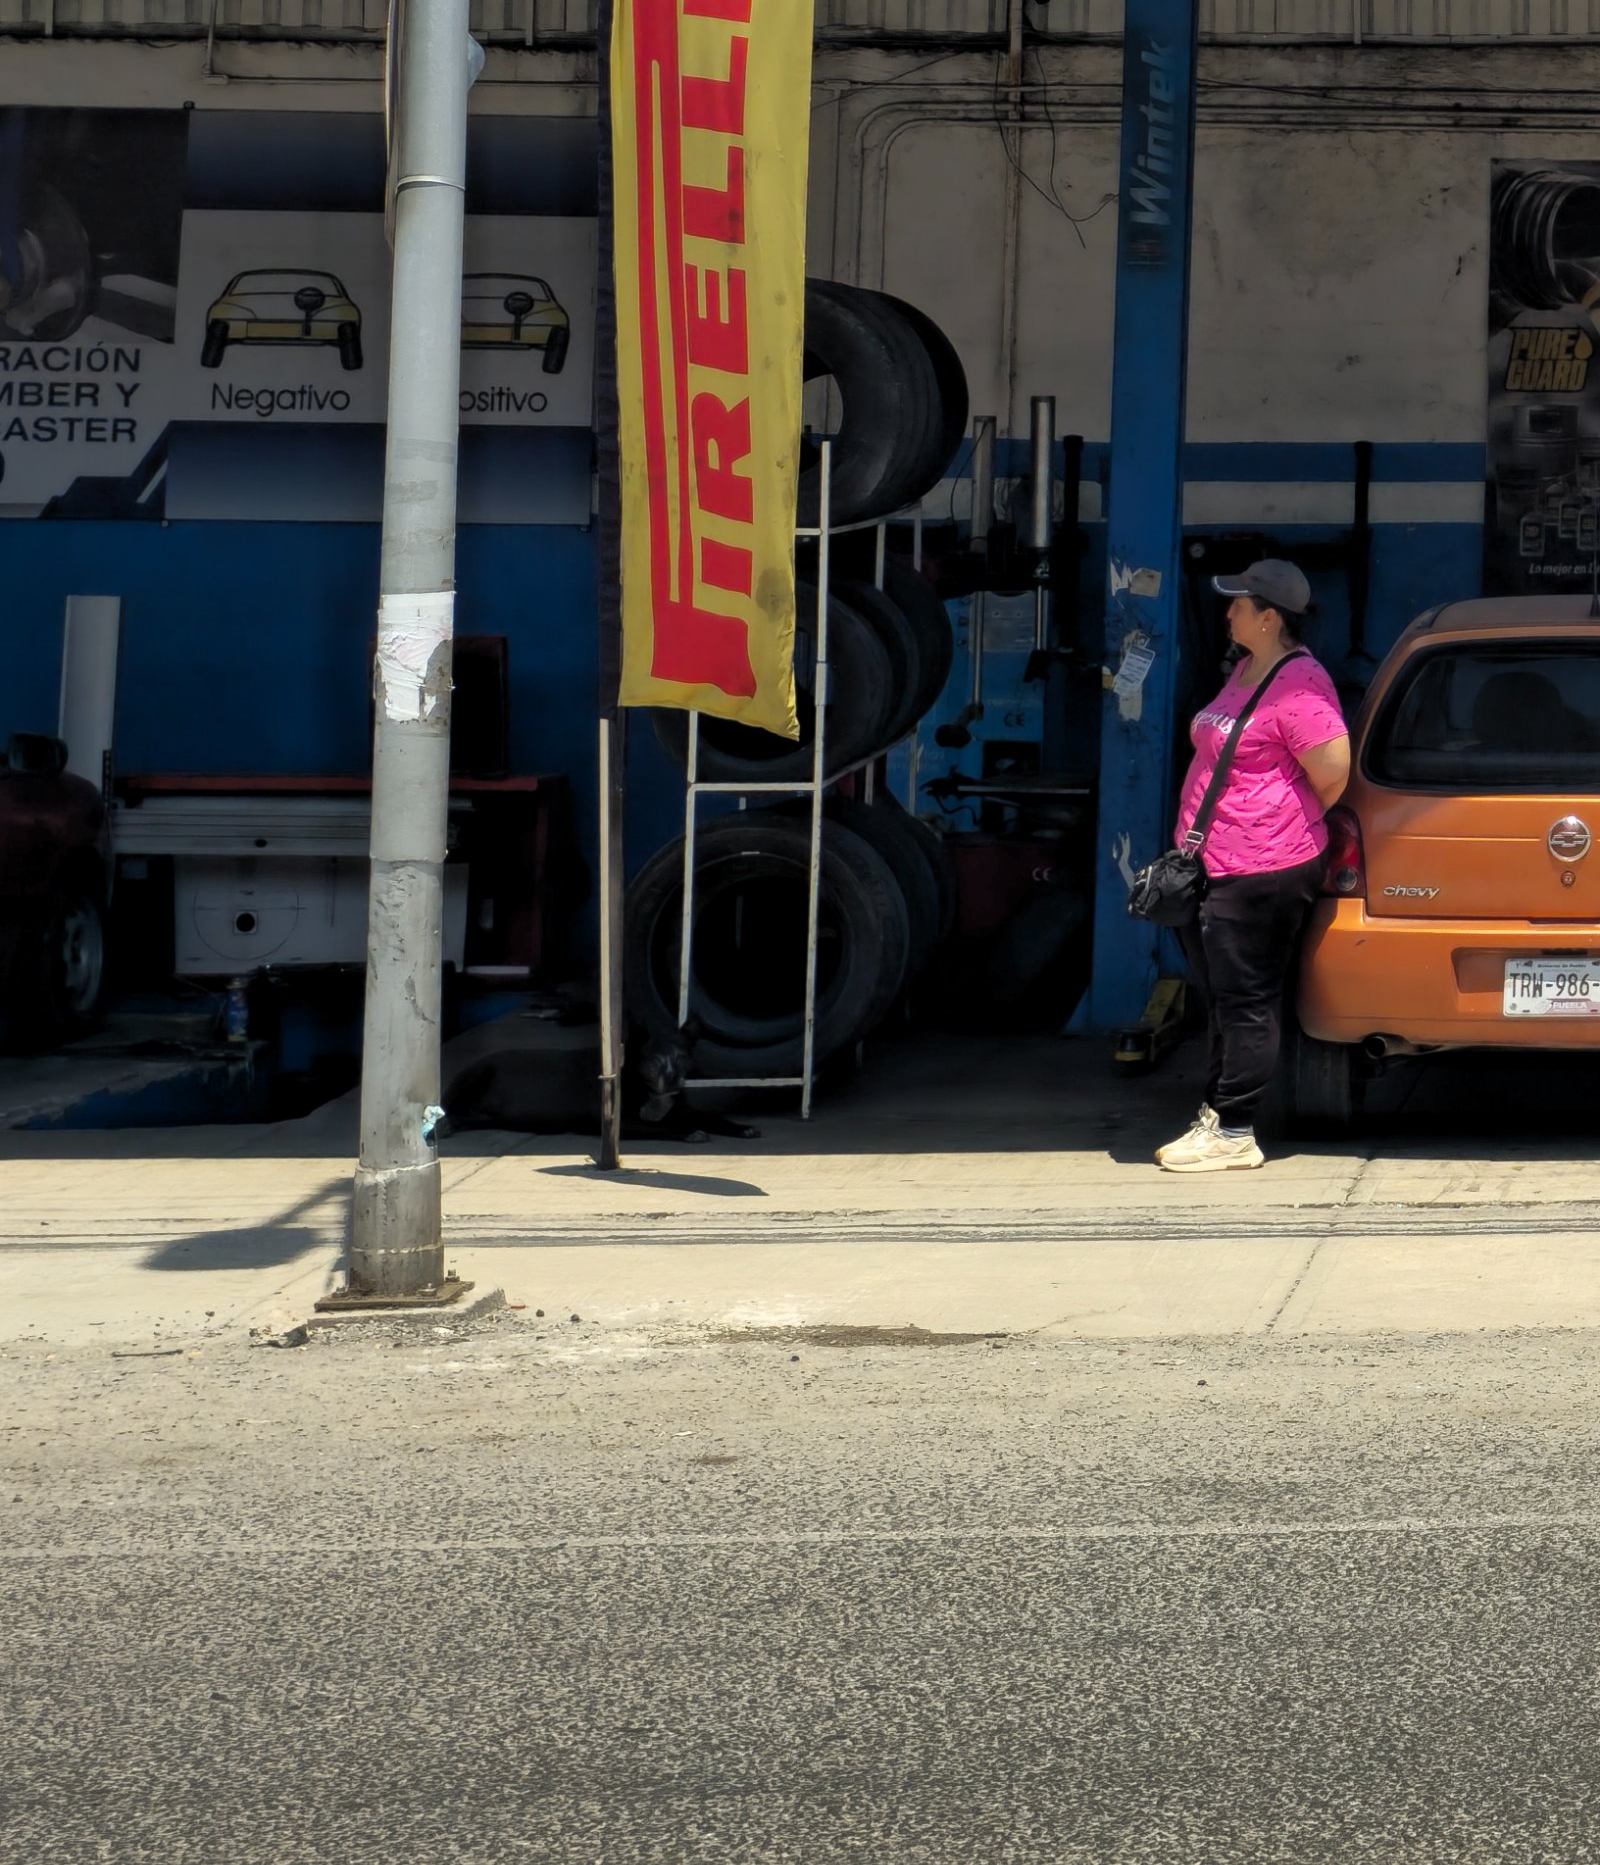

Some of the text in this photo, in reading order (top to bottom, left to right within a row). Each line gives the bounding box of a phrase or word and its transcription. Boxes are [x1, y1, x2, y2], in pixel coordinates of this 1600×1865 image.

[1129, 38, 1176, 226] Wintek
[1513, 328, 1576, 360] PURE
[1505, 360, 1588, 391] GUARD
[117, 383, 140, 408] Y
[211, 383, 351, 417] Negativo
[459, 386, 548, 413] ositivo
